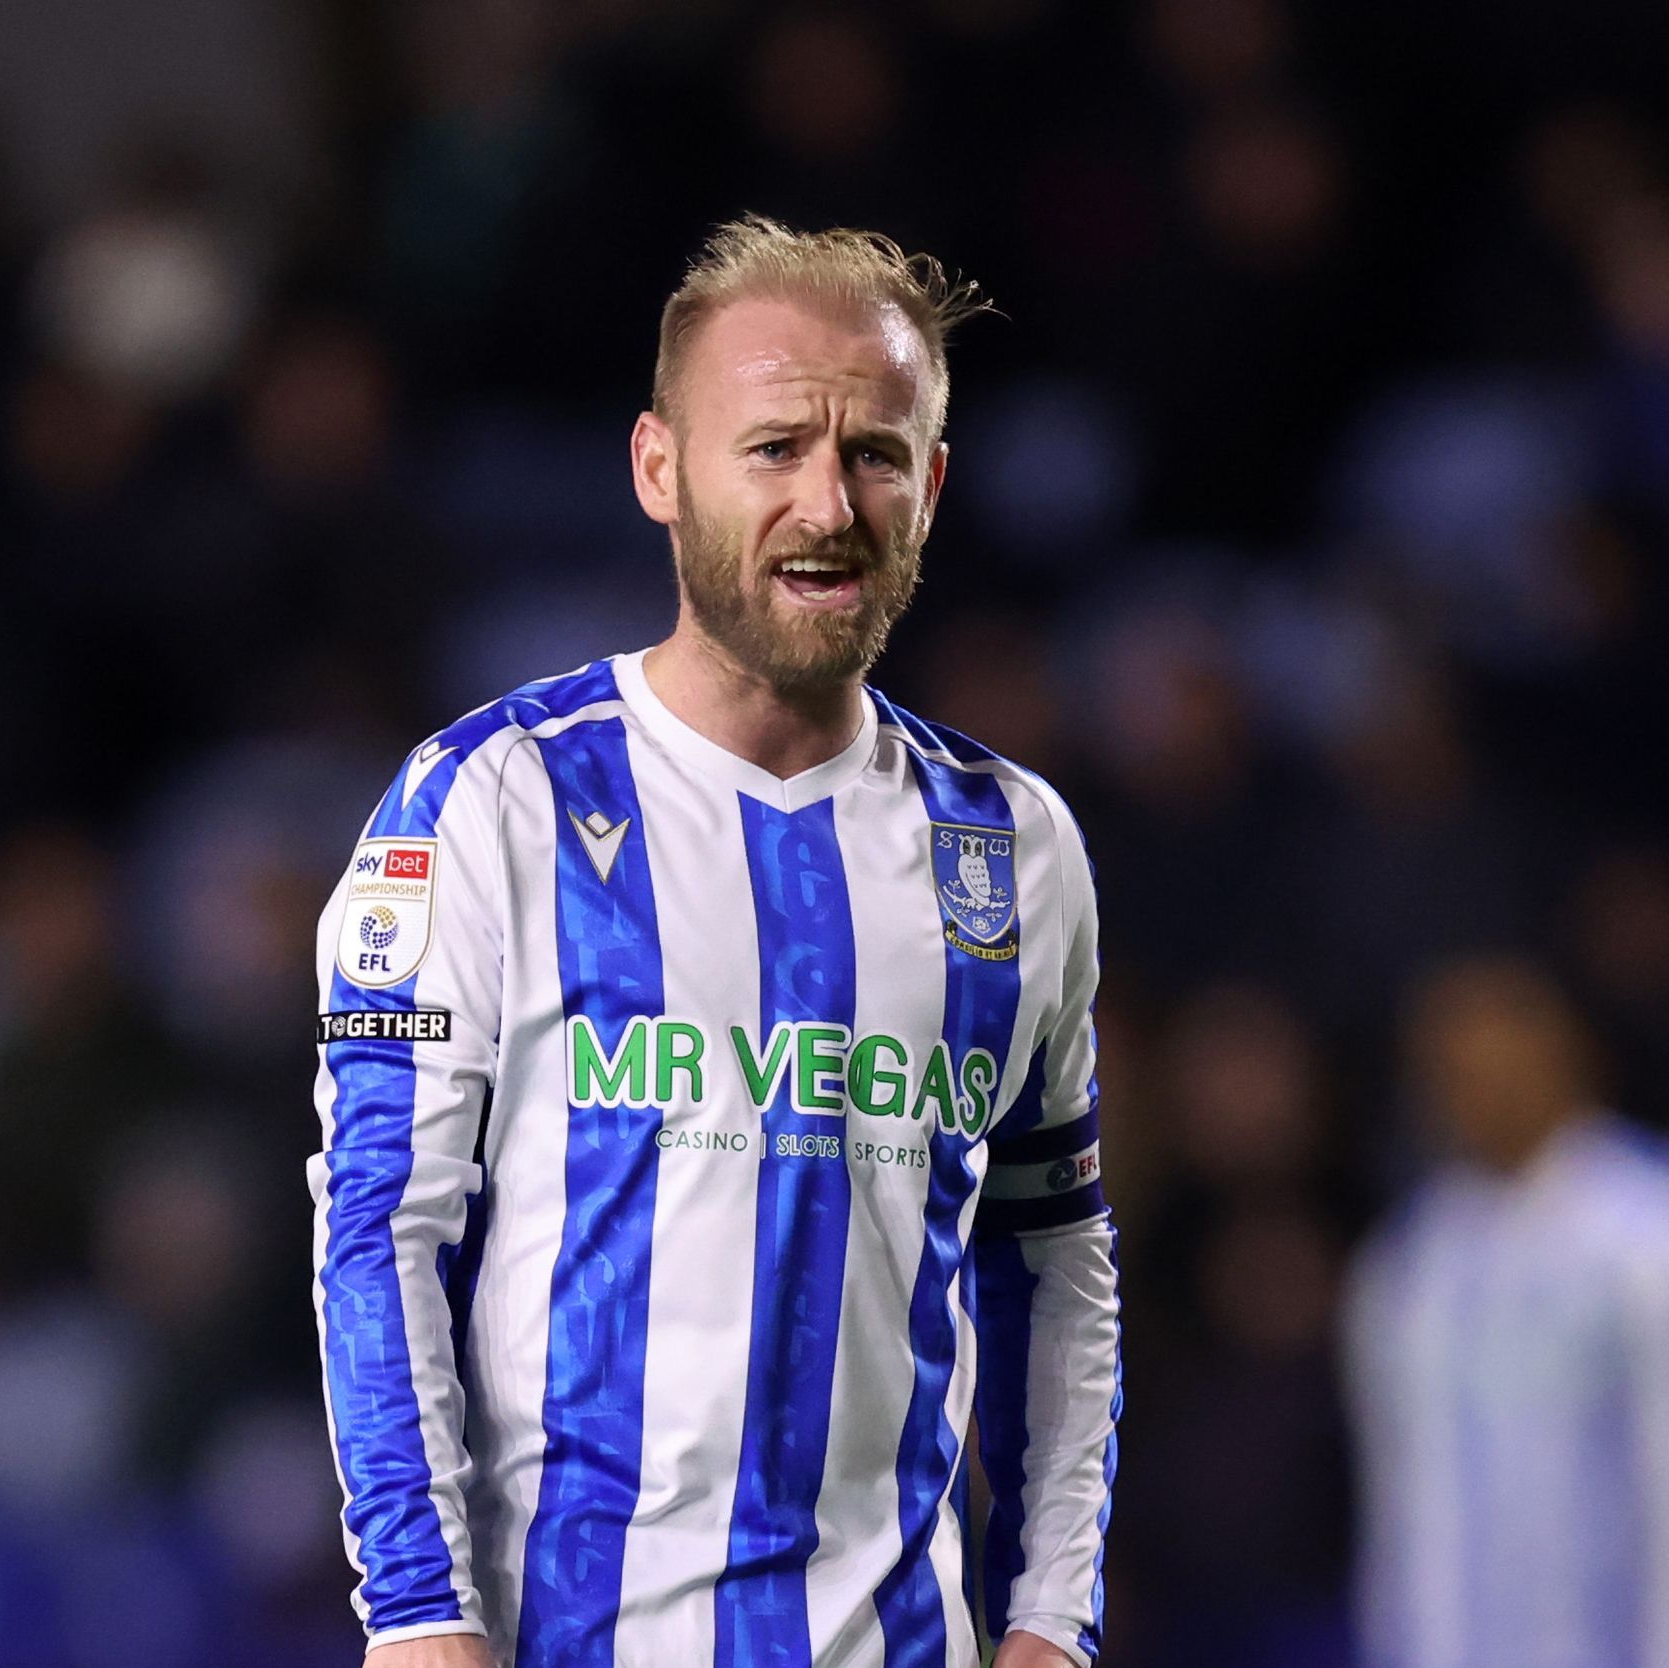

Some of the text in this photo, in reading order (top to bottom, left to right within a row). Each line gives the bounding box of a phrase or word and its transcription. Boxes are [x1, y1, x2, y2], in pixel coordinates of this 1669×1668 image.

[356, 852, 424, 875] sky bet
[351, 882, 427, 897] CHAMPIONSHIP
[358, 953, 391, 972] EFL
[572, 1020, 992, 1136] MR VEGAS
[655, 1129, 927, 1168] CASINO SLOTS SPORTS
